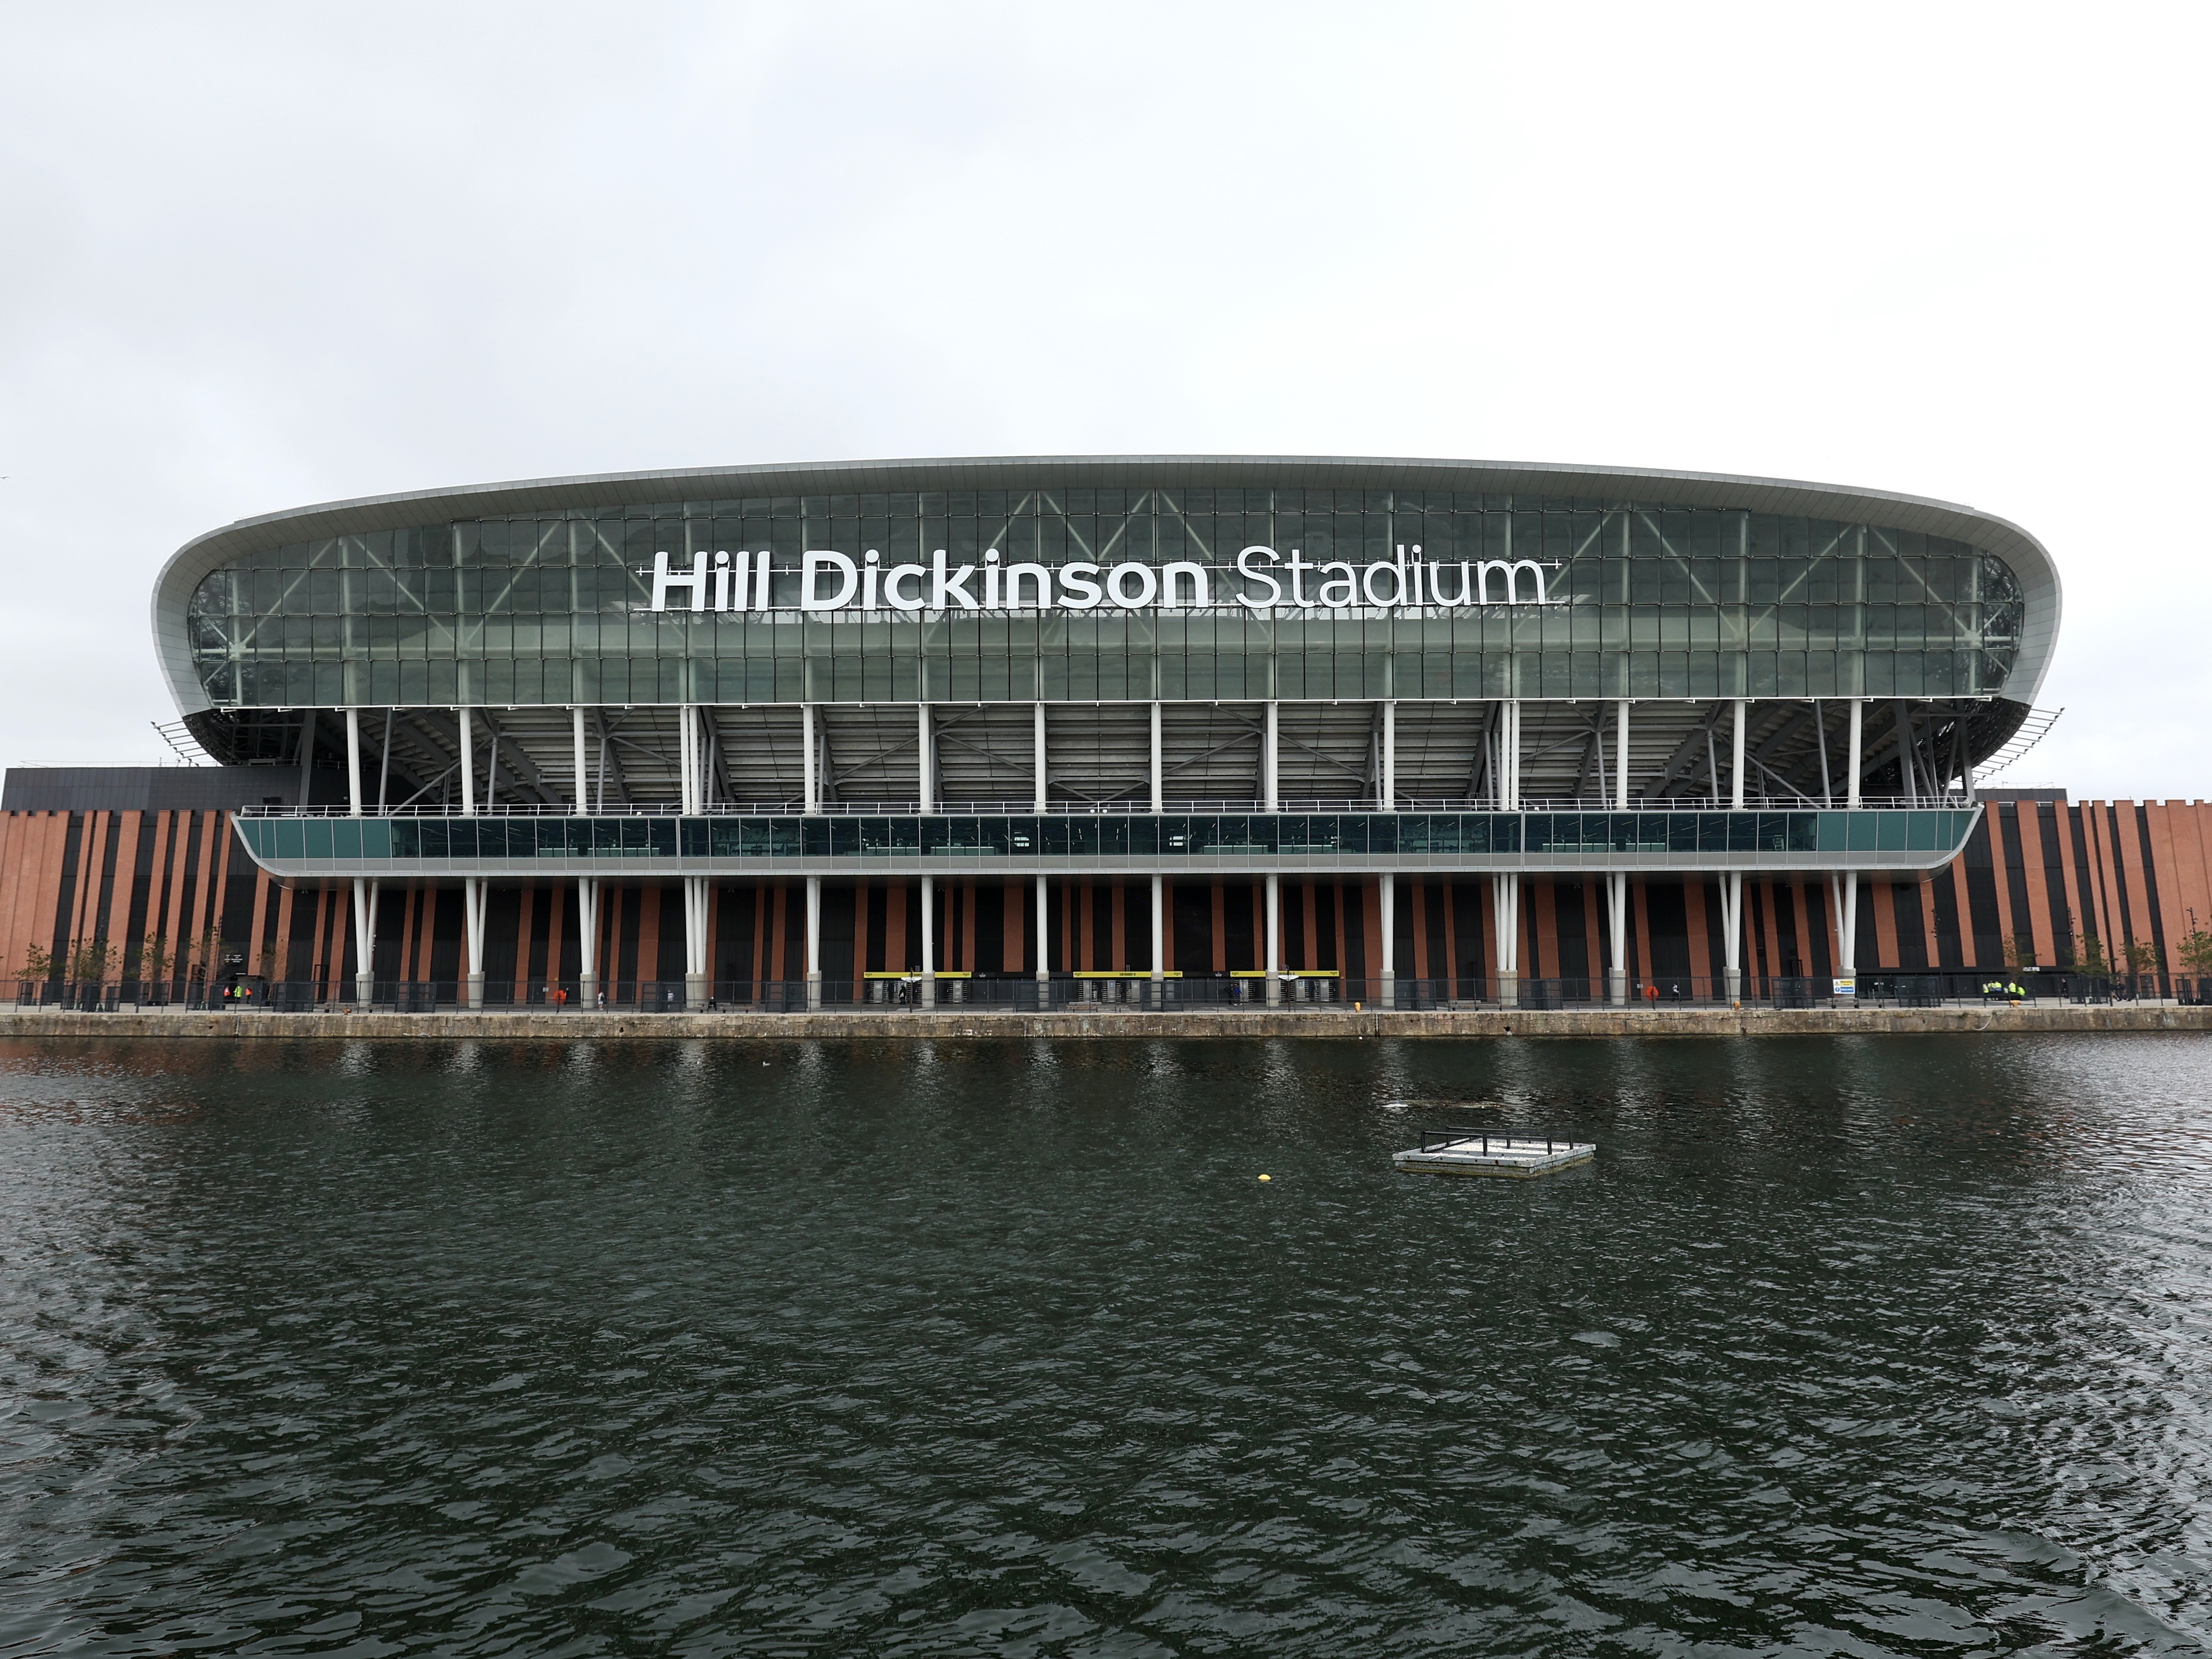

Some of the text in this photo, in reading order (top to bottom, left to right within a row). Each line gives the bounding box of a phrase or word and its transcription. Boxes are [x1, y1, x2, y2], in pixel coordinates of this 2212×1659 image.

[651, 545, 1548, 612] Hill Dickinson Stadium
